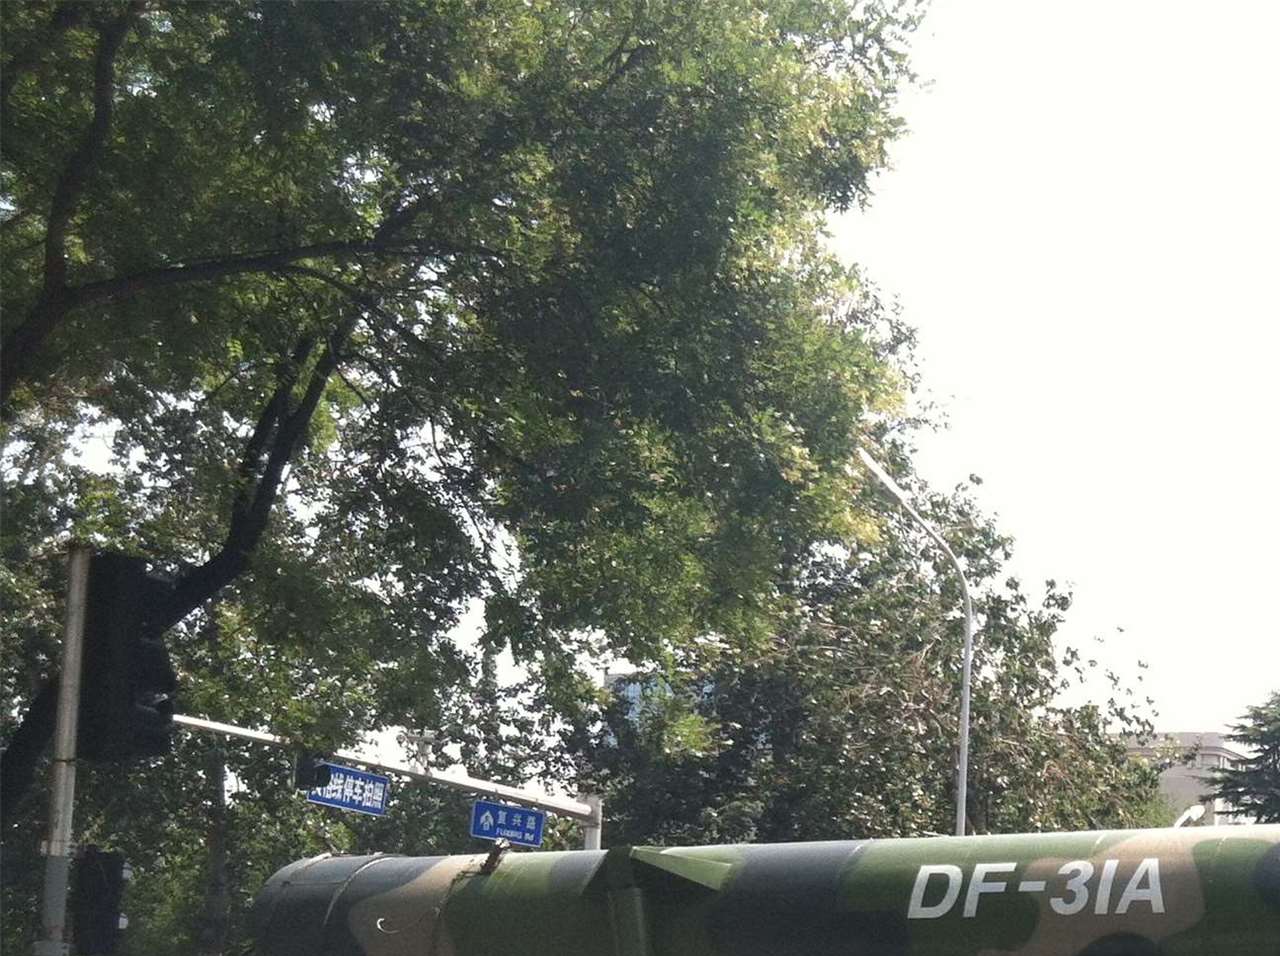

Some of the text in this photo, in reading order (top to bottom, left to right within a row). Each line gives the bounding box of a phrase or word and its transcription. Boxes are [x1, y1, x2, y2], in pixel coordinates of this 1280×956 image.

[497, 810, 537, 830] 复兴路
[907, 857, 1165, 919] DF-31A
